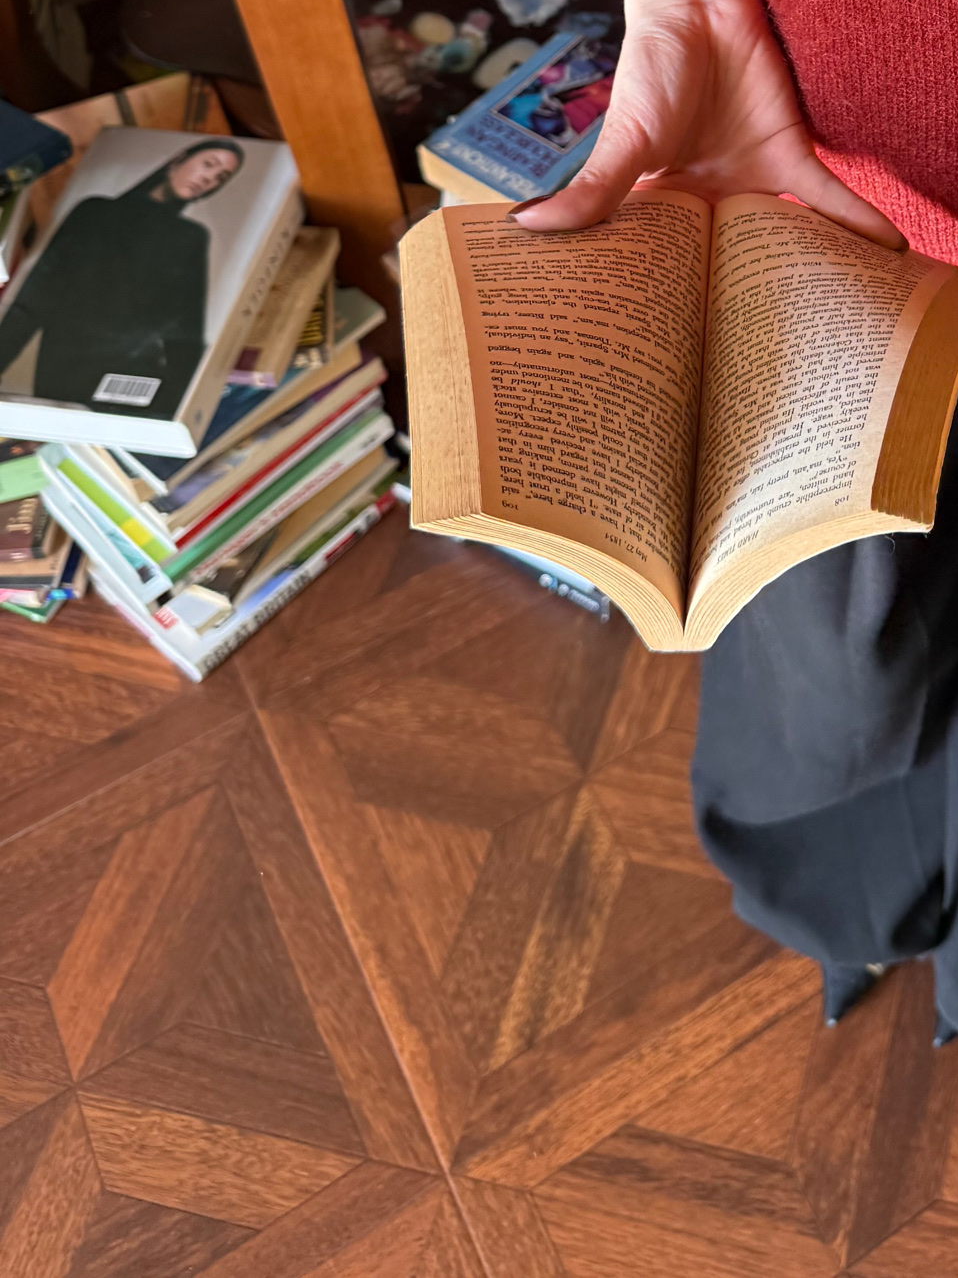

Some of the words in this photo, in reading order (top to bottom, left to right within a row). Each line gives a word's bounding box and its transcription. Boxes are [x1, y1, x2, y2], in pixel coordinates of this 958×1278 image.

[484, 330, 536, 340] individual,
[487, 345, 521, 354] begged
[526, 348, 552, 356] again
[612, 348, 630, 361] Mrs.
[557, 352, 574, 361] and
[579, 355, 605, 368] again,
[845, 382, 862, 391] had
[859, 388, 874, 396] rise
[788, 389, 827, 405] affections
[828, 394, 842, 403] the
[838, 396, 872, 408] headed,
[799, 399, 824, 409] world.
[797, 404, 833, 419] cautious,
[840, 405, 869, 416] weekly
[810, 413, 833, 423] wage.
[856, 414, 867, 422] he
[763, 416, 792, 434] prudent
[792, 421, 804, 431] He
[816, 417, 851, 432] received
[835, 422, 865, 433] former
[518, 430, 543, 441] every
[772, 429, 786, 441] had
[774, 430, 802, 446] present
[822, 430, 830, 438] in
[839, 434, 852, 443] He
[498, 437, 517, 447] that
[523, 441, 532, 450] in
[550, 437, 586, 452] received
[803, 435, 816, 446] the
[816, 439, 834, 451] held
[537, 444, 555, 454] him
[762, 443, 771, 452] at
[797, 446, 811, 456] the
[518, 448, 552, 462] making
[560, 449, 588, 462] regard
[749, 441, 800, 467] establishment,
[498, 455, 523, 466] years
[592, 459, 606, 471] but
[753, 451, 794, 474] respectable
[848, 460, 857, 468] of
[500, 465, 522, 476] both
[541, 464, 576, 479] deemed
[593, 469, 605, 480] my
[832, 470, 855, 483] hand
[500, 474, 524, 487] here,
[527, 471, 577, 491] improbable
[580, 476, 600, 489] have
[766, 470, 790, 486] pretty
[501, 486, 519, 494] said
[529, 482, 550, 492] trust
[750, 483, 764, 494] fair,
[799, 478, 828, 491] mitten,
[583, 487, 617, 506] However
[604, 484, 626, 499] might
[796, 479, 852, 504] imperceptible
[565, 491, 584, 505] hold
[834, 495, 850, 506] 108
[501, 500, 518, 510] 109
[557, 498, 586, 516] charge
[766, 500, 792, 516] crumb
[600, 514, 618, 528] have
[755, 512, 764, 524] of
[737, 530, 759, 548] HARD
[716, 544, 735, 564] TIMES
